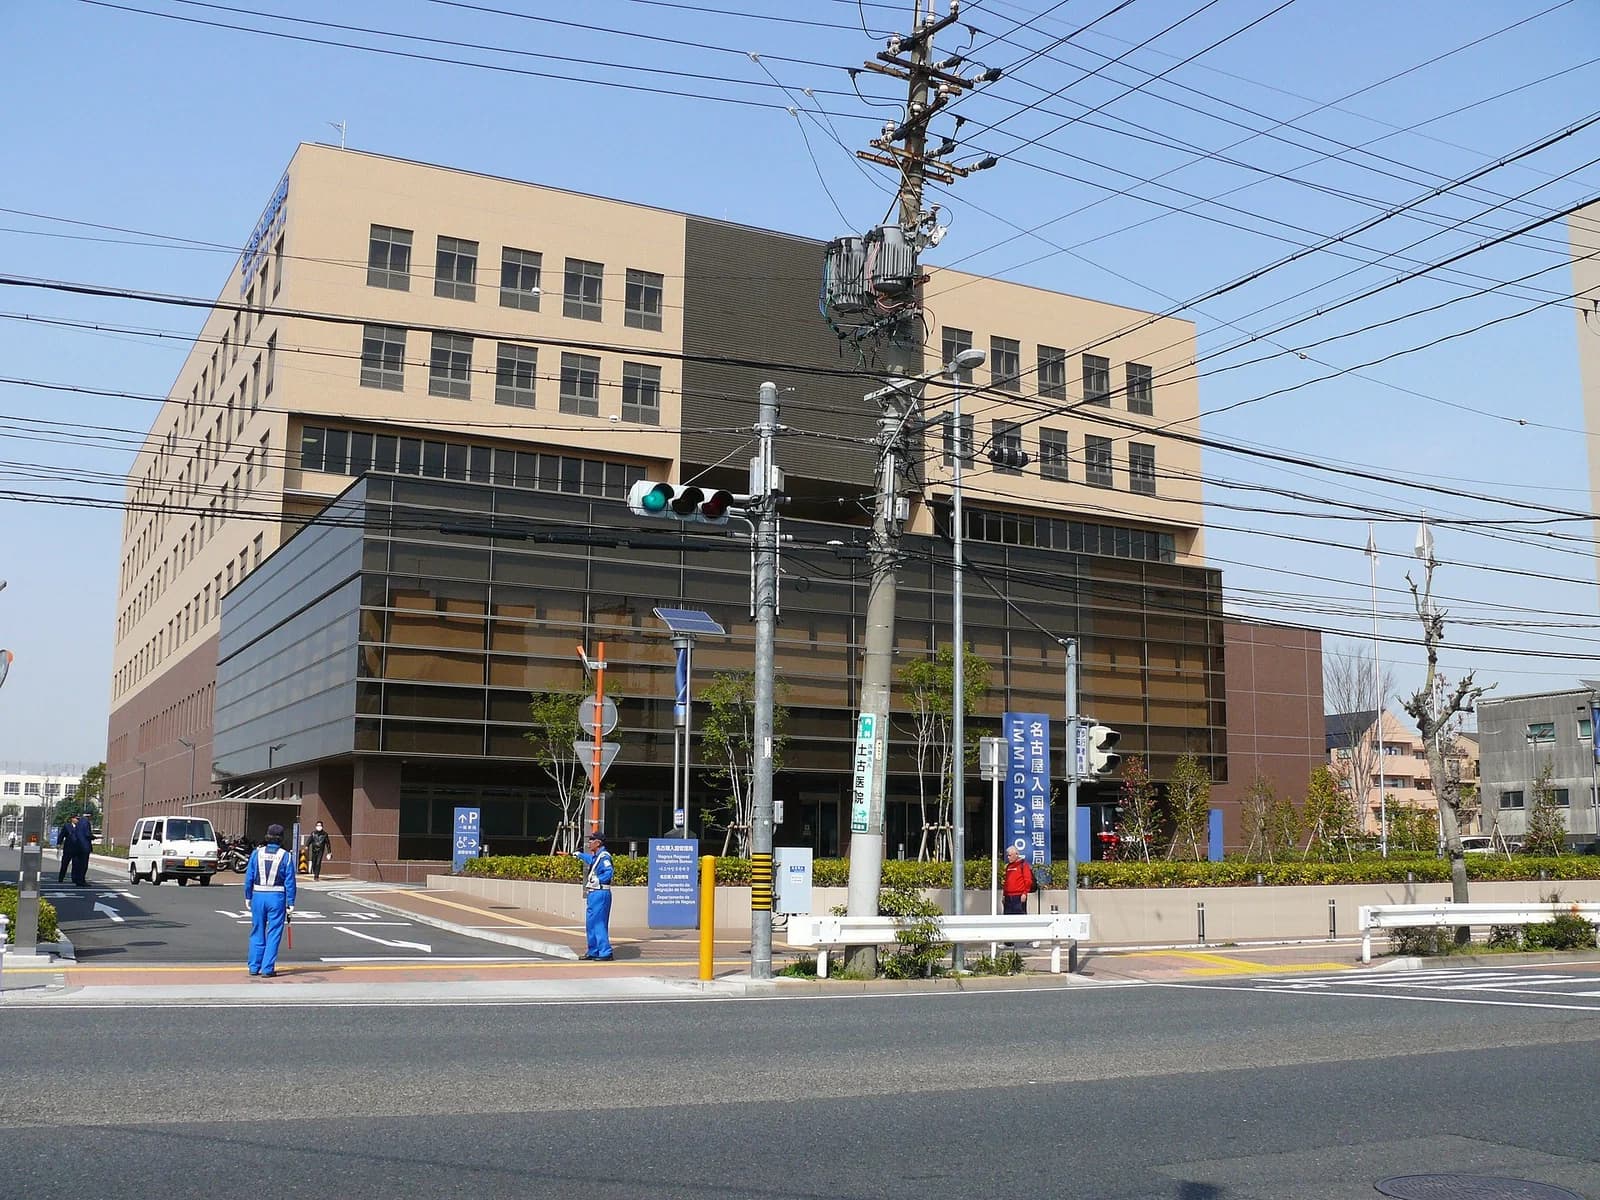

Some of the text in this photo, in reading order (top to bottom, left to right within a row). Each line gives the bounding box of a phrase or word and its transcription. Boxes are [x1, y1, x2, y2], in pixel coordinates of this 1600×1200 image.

[855, 743, 867, 805] 土古医院
[1030, 722, 1044, 864] 名古屋入国管理局
[469, 812, 478, 824] P
